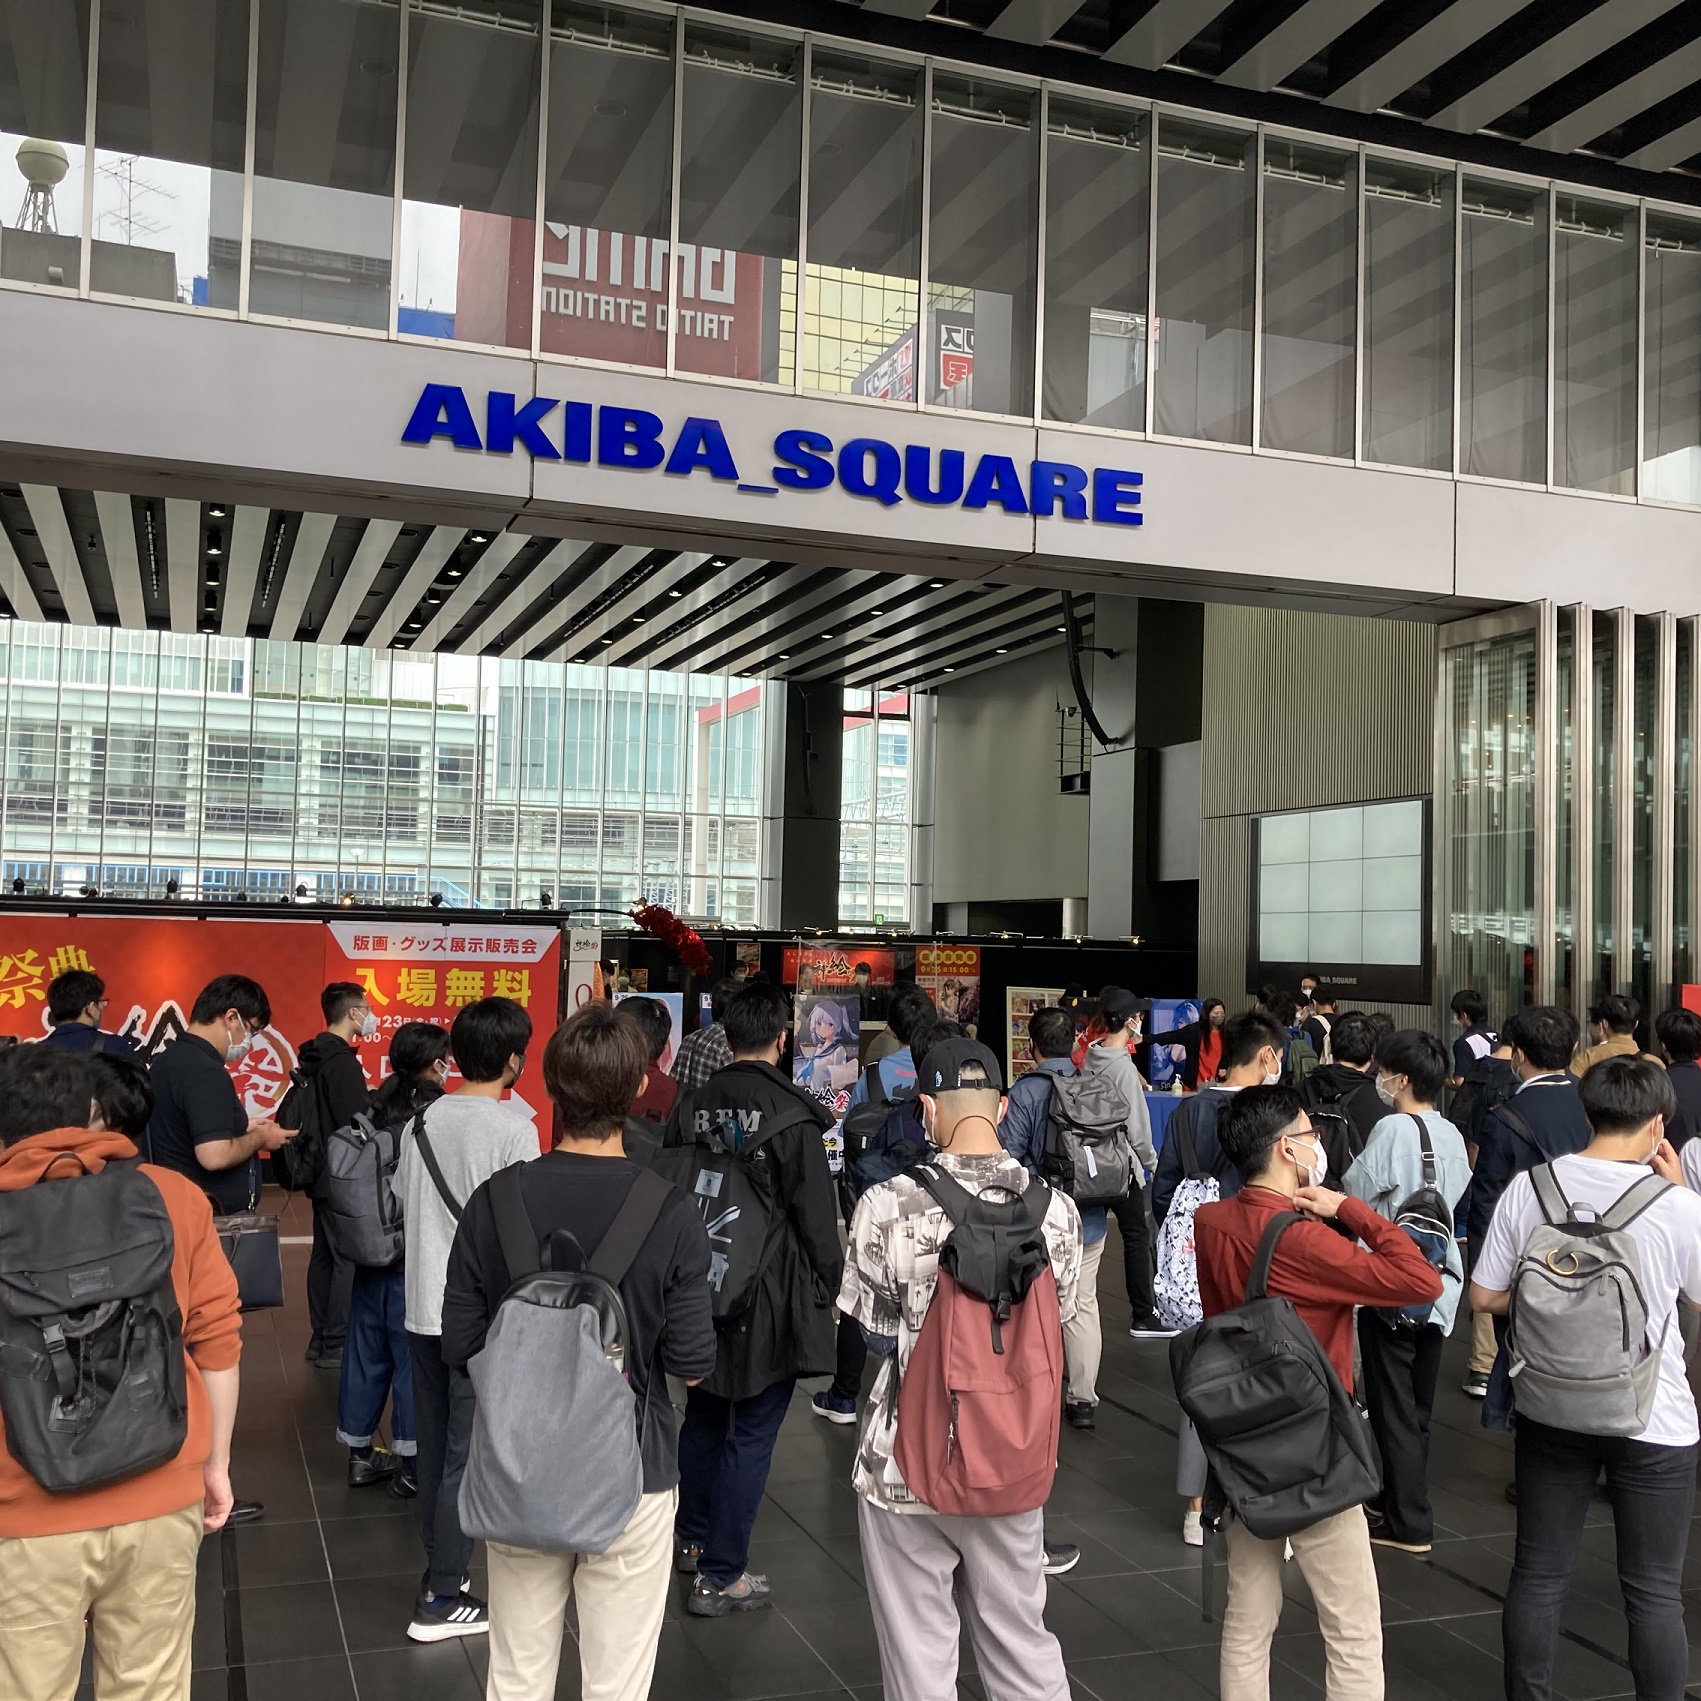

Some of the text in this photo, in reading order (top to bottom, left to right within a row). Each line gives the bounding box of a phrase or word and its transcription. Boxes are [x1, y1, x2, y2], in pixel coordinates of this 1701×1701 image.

[401, 383, 1144, 526] AKIBA_SQUARE
[355, 967, 532, 1008] 入場無料
